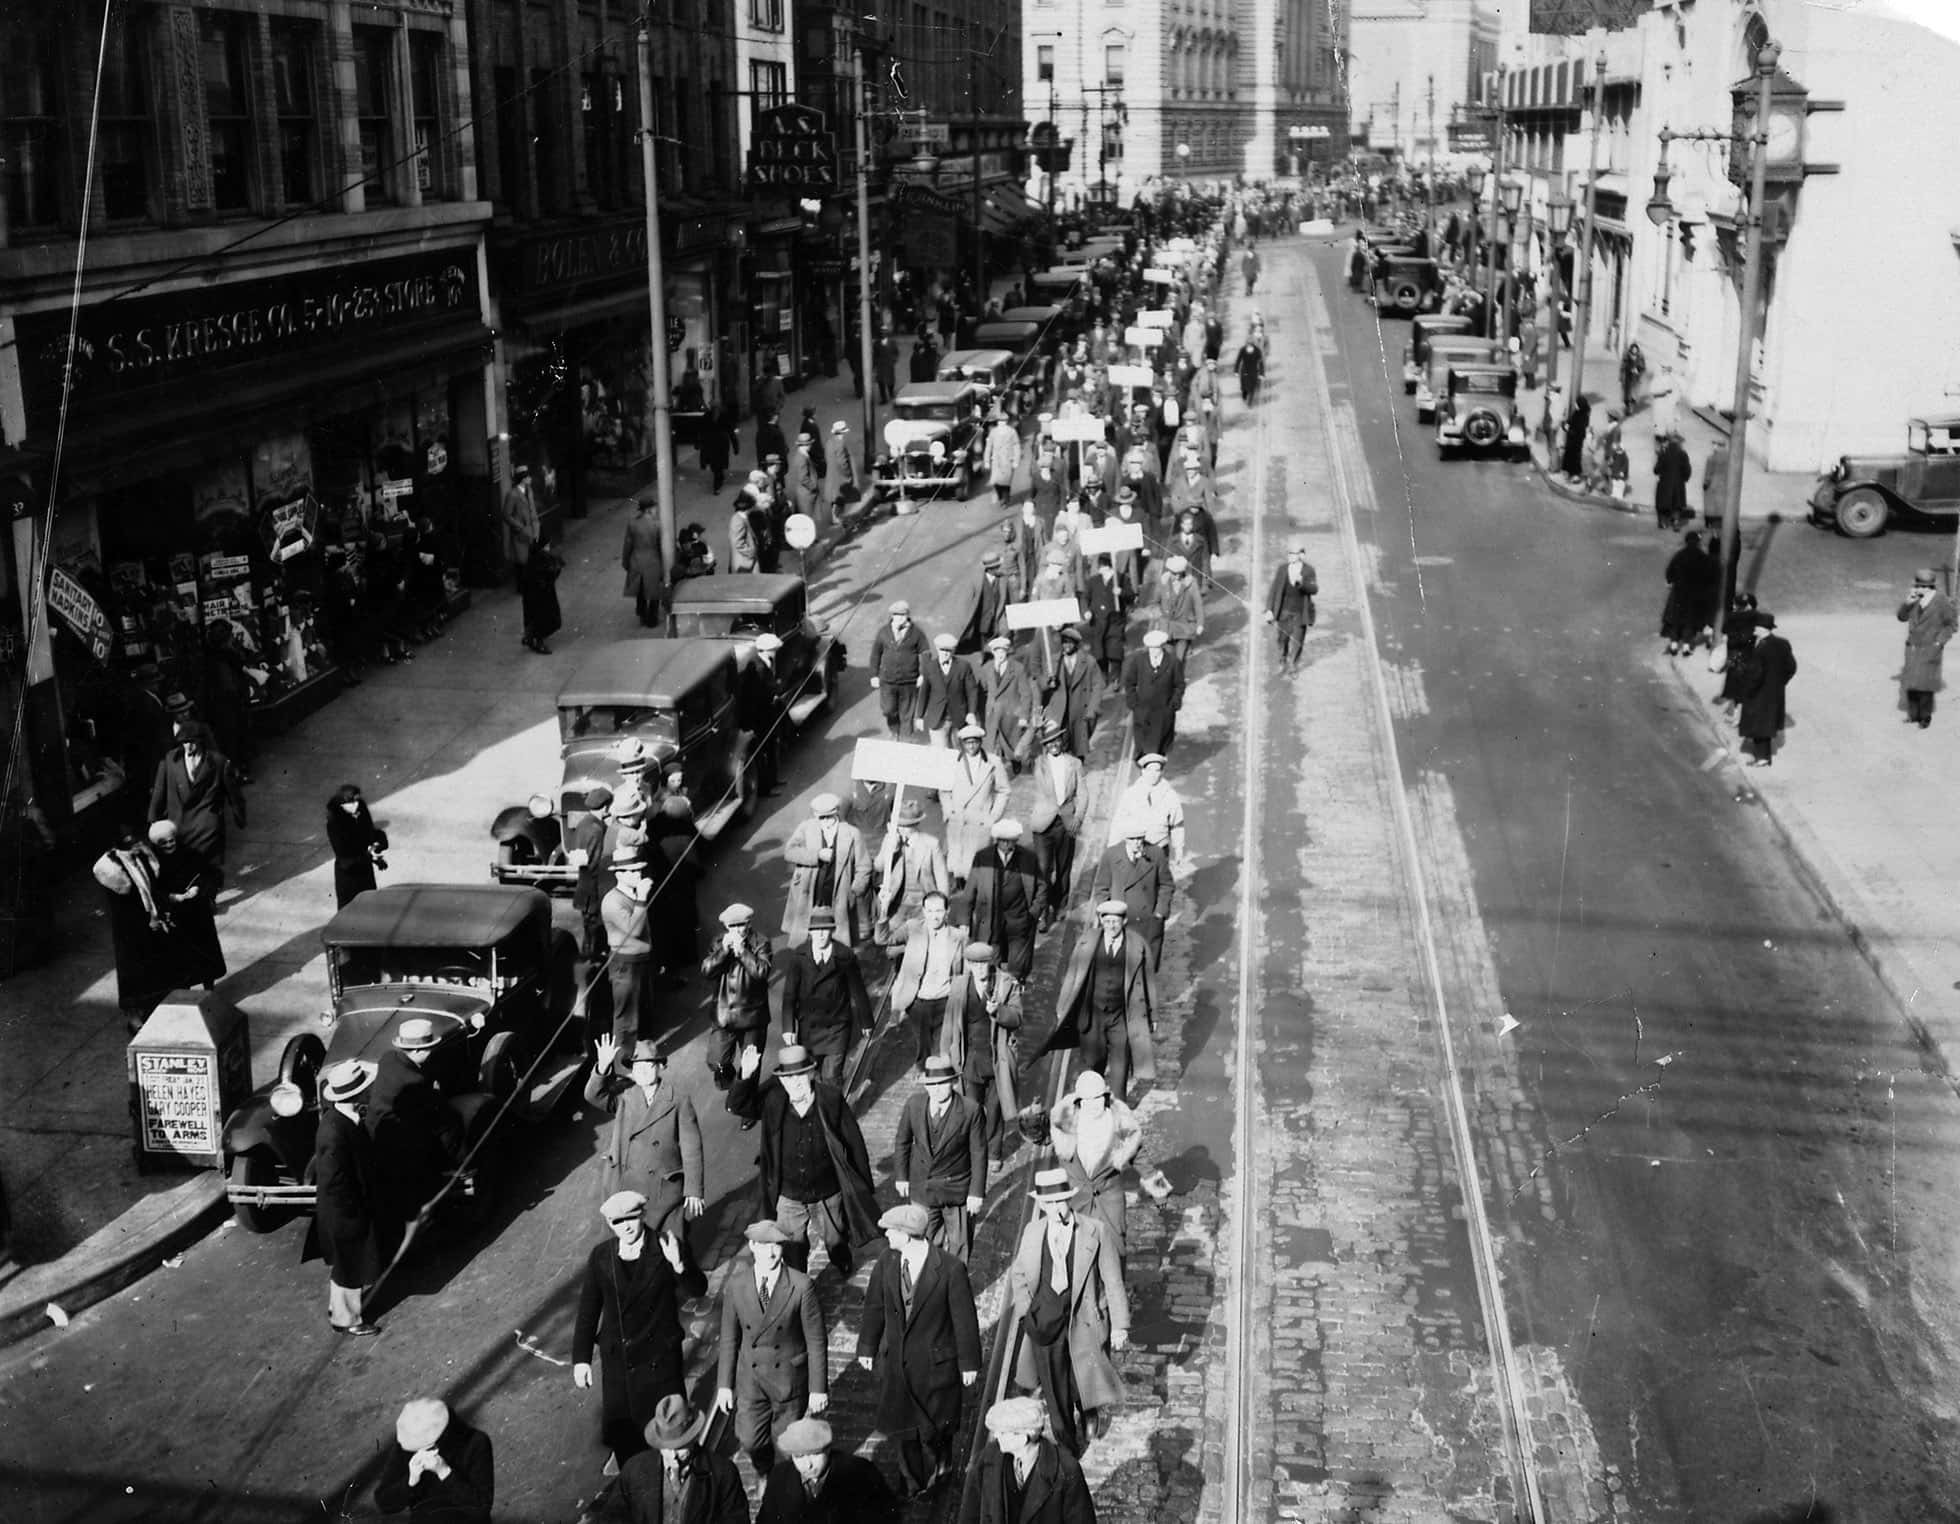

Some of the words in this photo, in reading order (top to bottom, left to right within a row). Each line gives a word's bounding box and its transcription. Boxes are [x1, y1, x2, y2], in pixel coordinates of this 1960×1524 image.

[753, 164, 833, 184] SHOES
[163, 307, 263, 359] KRESGE
[266, 302, 298, 338] CO.
[384, 273, 436, 313] STORE
[53, 572, 92, 611] SANITARY
[51, 588, 90, 628] NAPKINS
[93, 607, 104, 627] 10
[92, 637, 105, 659] 10
[143, 1058, 206, 1070] STANLEY
[147, 1085, 174, 1100] HELEN
[177, 1086, 206, 1101] HAYES
[148, 1101, 171, 1115] GARY
[174, 1102, 207, 1116] COOPER
[149, 1119, 208, 1130] FAREWELL
[152, 1130, 166, 1139] TO
[173, 1131, 208, 1140] ARMS
